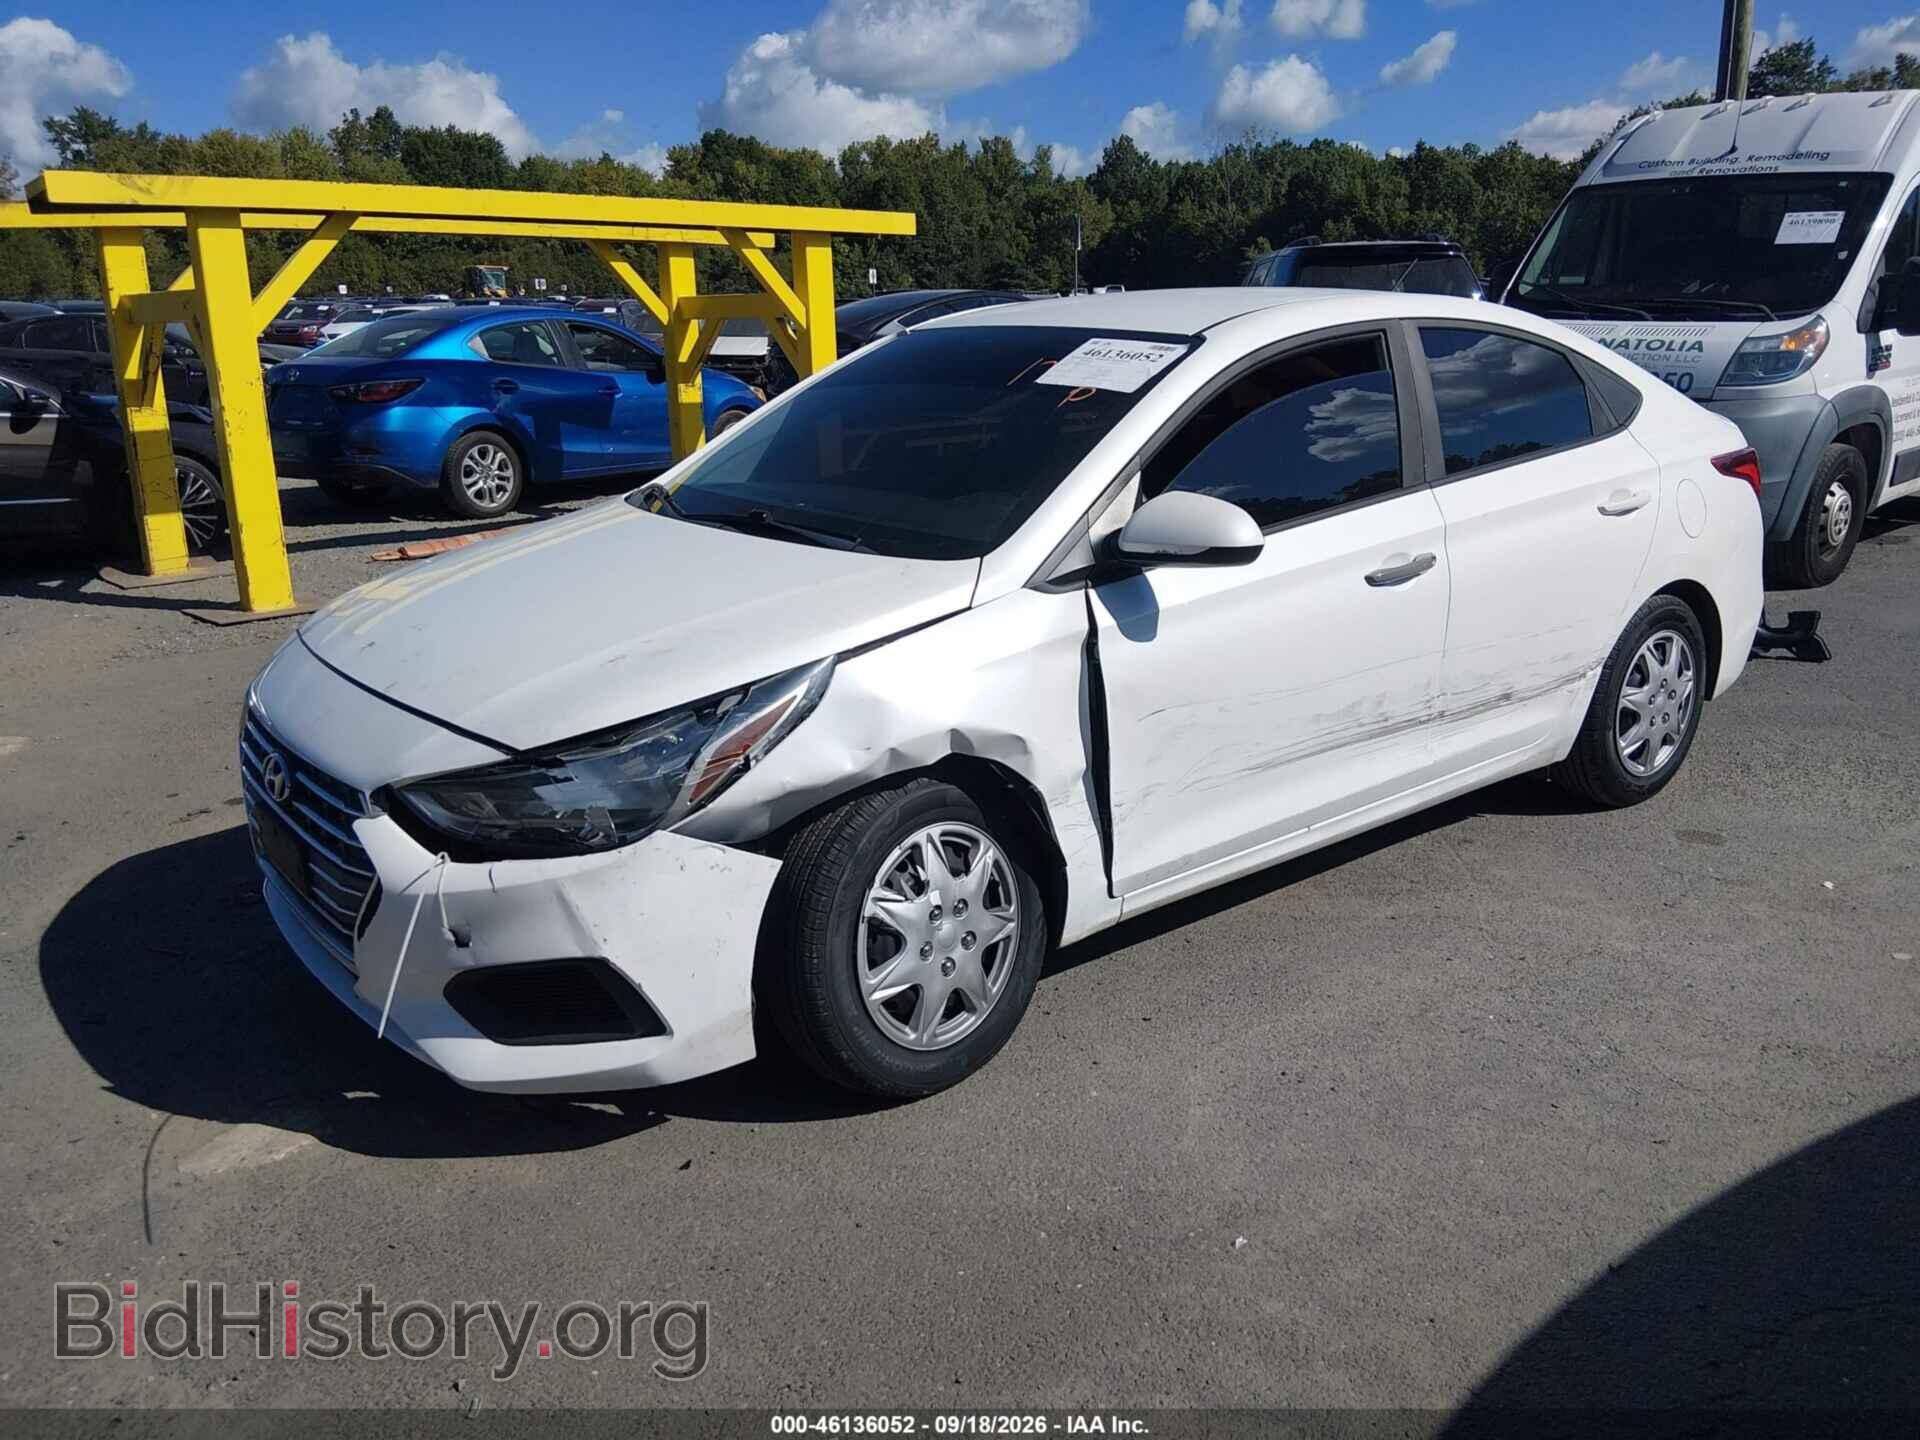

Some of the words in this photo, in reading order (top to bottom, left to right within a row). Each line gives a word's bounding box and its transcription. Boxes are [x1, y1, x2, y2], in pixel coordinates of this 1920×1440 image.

[1638, 158, 1684, 169] Custom
[1746, 150, 1830, 162] Remodeling
[1697, 164, 1779, 176] Renovations
[1598, 338, 1704, 353] NATOLIA
[1083, 349, 1163, 363] 46136052
[1677, 353, 1703, 363] LLC
[1651, 371, 1695, 394] 50
